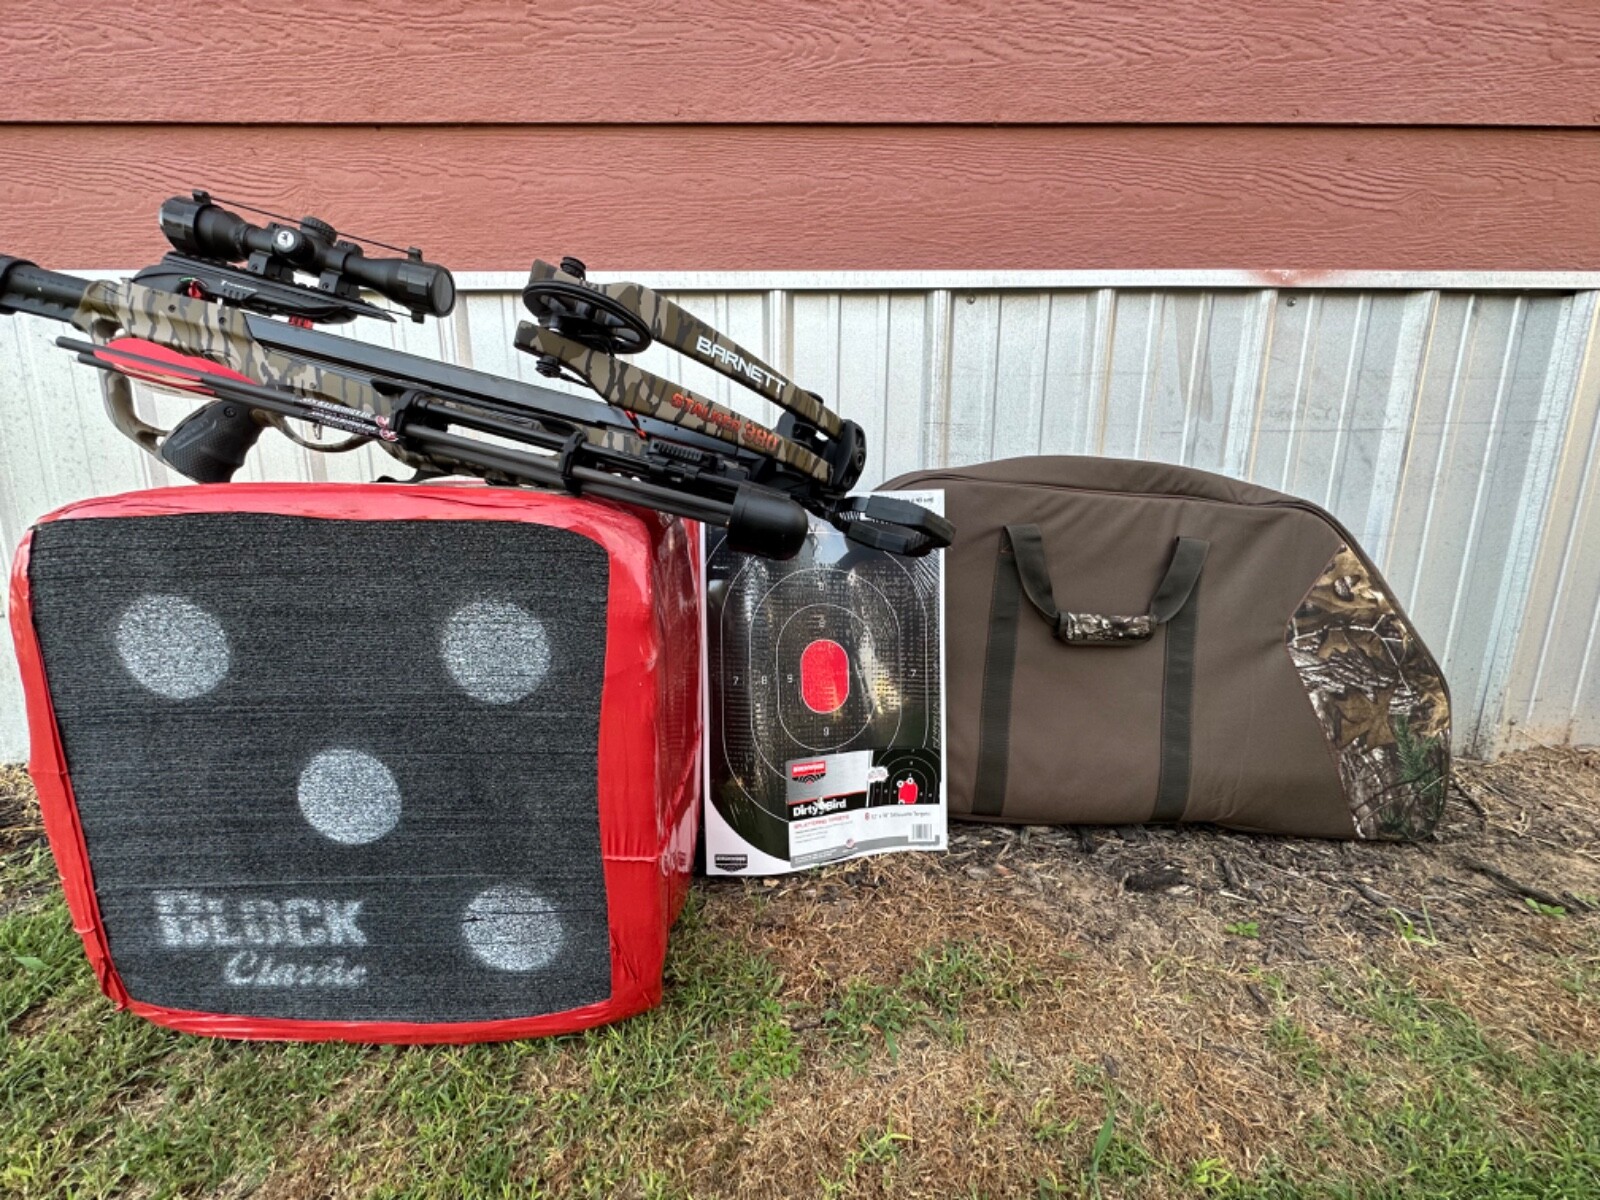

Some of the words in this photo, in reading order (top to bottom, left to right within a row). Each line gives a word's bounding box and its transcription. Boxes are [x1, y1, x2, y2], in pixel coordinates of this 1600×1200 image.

[695, 335, 787, 395] BARNETT
[670, 392, 742, 433] STALKER
[741, 421, 780, 452] 380
[732, 676, 739, 686] 7
[910, 669, 917, 678] 7
[823, 727, 830, 737] 9
[793, 804, 818, 817] Dirty
[827, 798, 847, 812] Bird
[153, 890, 369, 947] BLOCK
